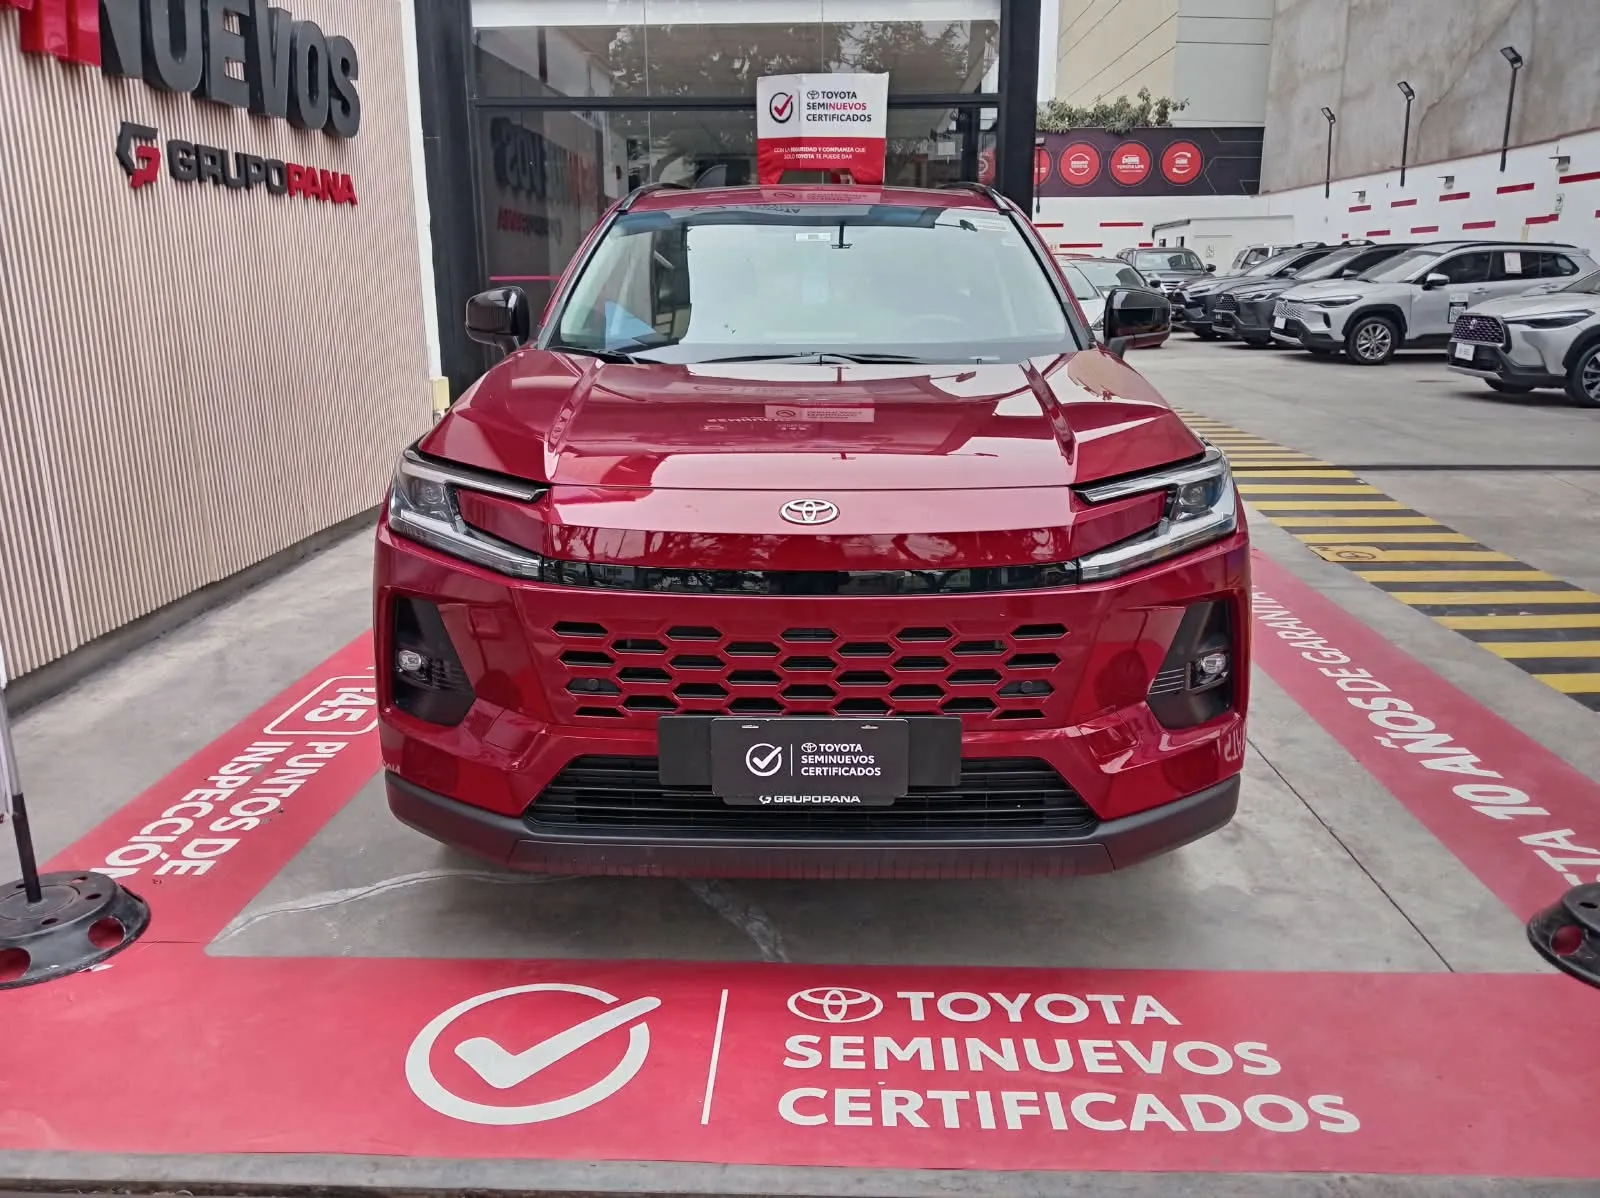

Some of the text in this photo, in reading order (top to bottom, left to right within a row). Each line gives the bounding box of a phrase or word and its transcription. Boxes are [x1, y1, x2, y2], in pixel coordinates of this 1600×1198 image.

[806, 102, 867, 110] SEMINUEVOS
[821, 91, 857, 99] TOYOTA
[806, 114, 872, 122] CERTIFICADOS
[167, 138, 358, 207] GRUPOPANA
[1318, 667, 1392, 692] DE
[304, 687, 377, 722] 145
[819, 743, 863, 753] TOYOTA
[1347, 697, 1504, 778] AÑOS
[801, 755, 875, 764] SEMINUEVOS
[801, 766, 881, 776] CERTIFICADOS
[153, 741, 348, 876] PUNTOS DE
[774, 795, 861, 803] GRUPOPANA
[1452, 784, 1550, 820] 10
[896, 991, 1183, 1026] TOYOTA
[782, 1034, 1282, 1076] SEMINUEVOS
[778, 1087, 1360, 1133] CERTIFICADOS
